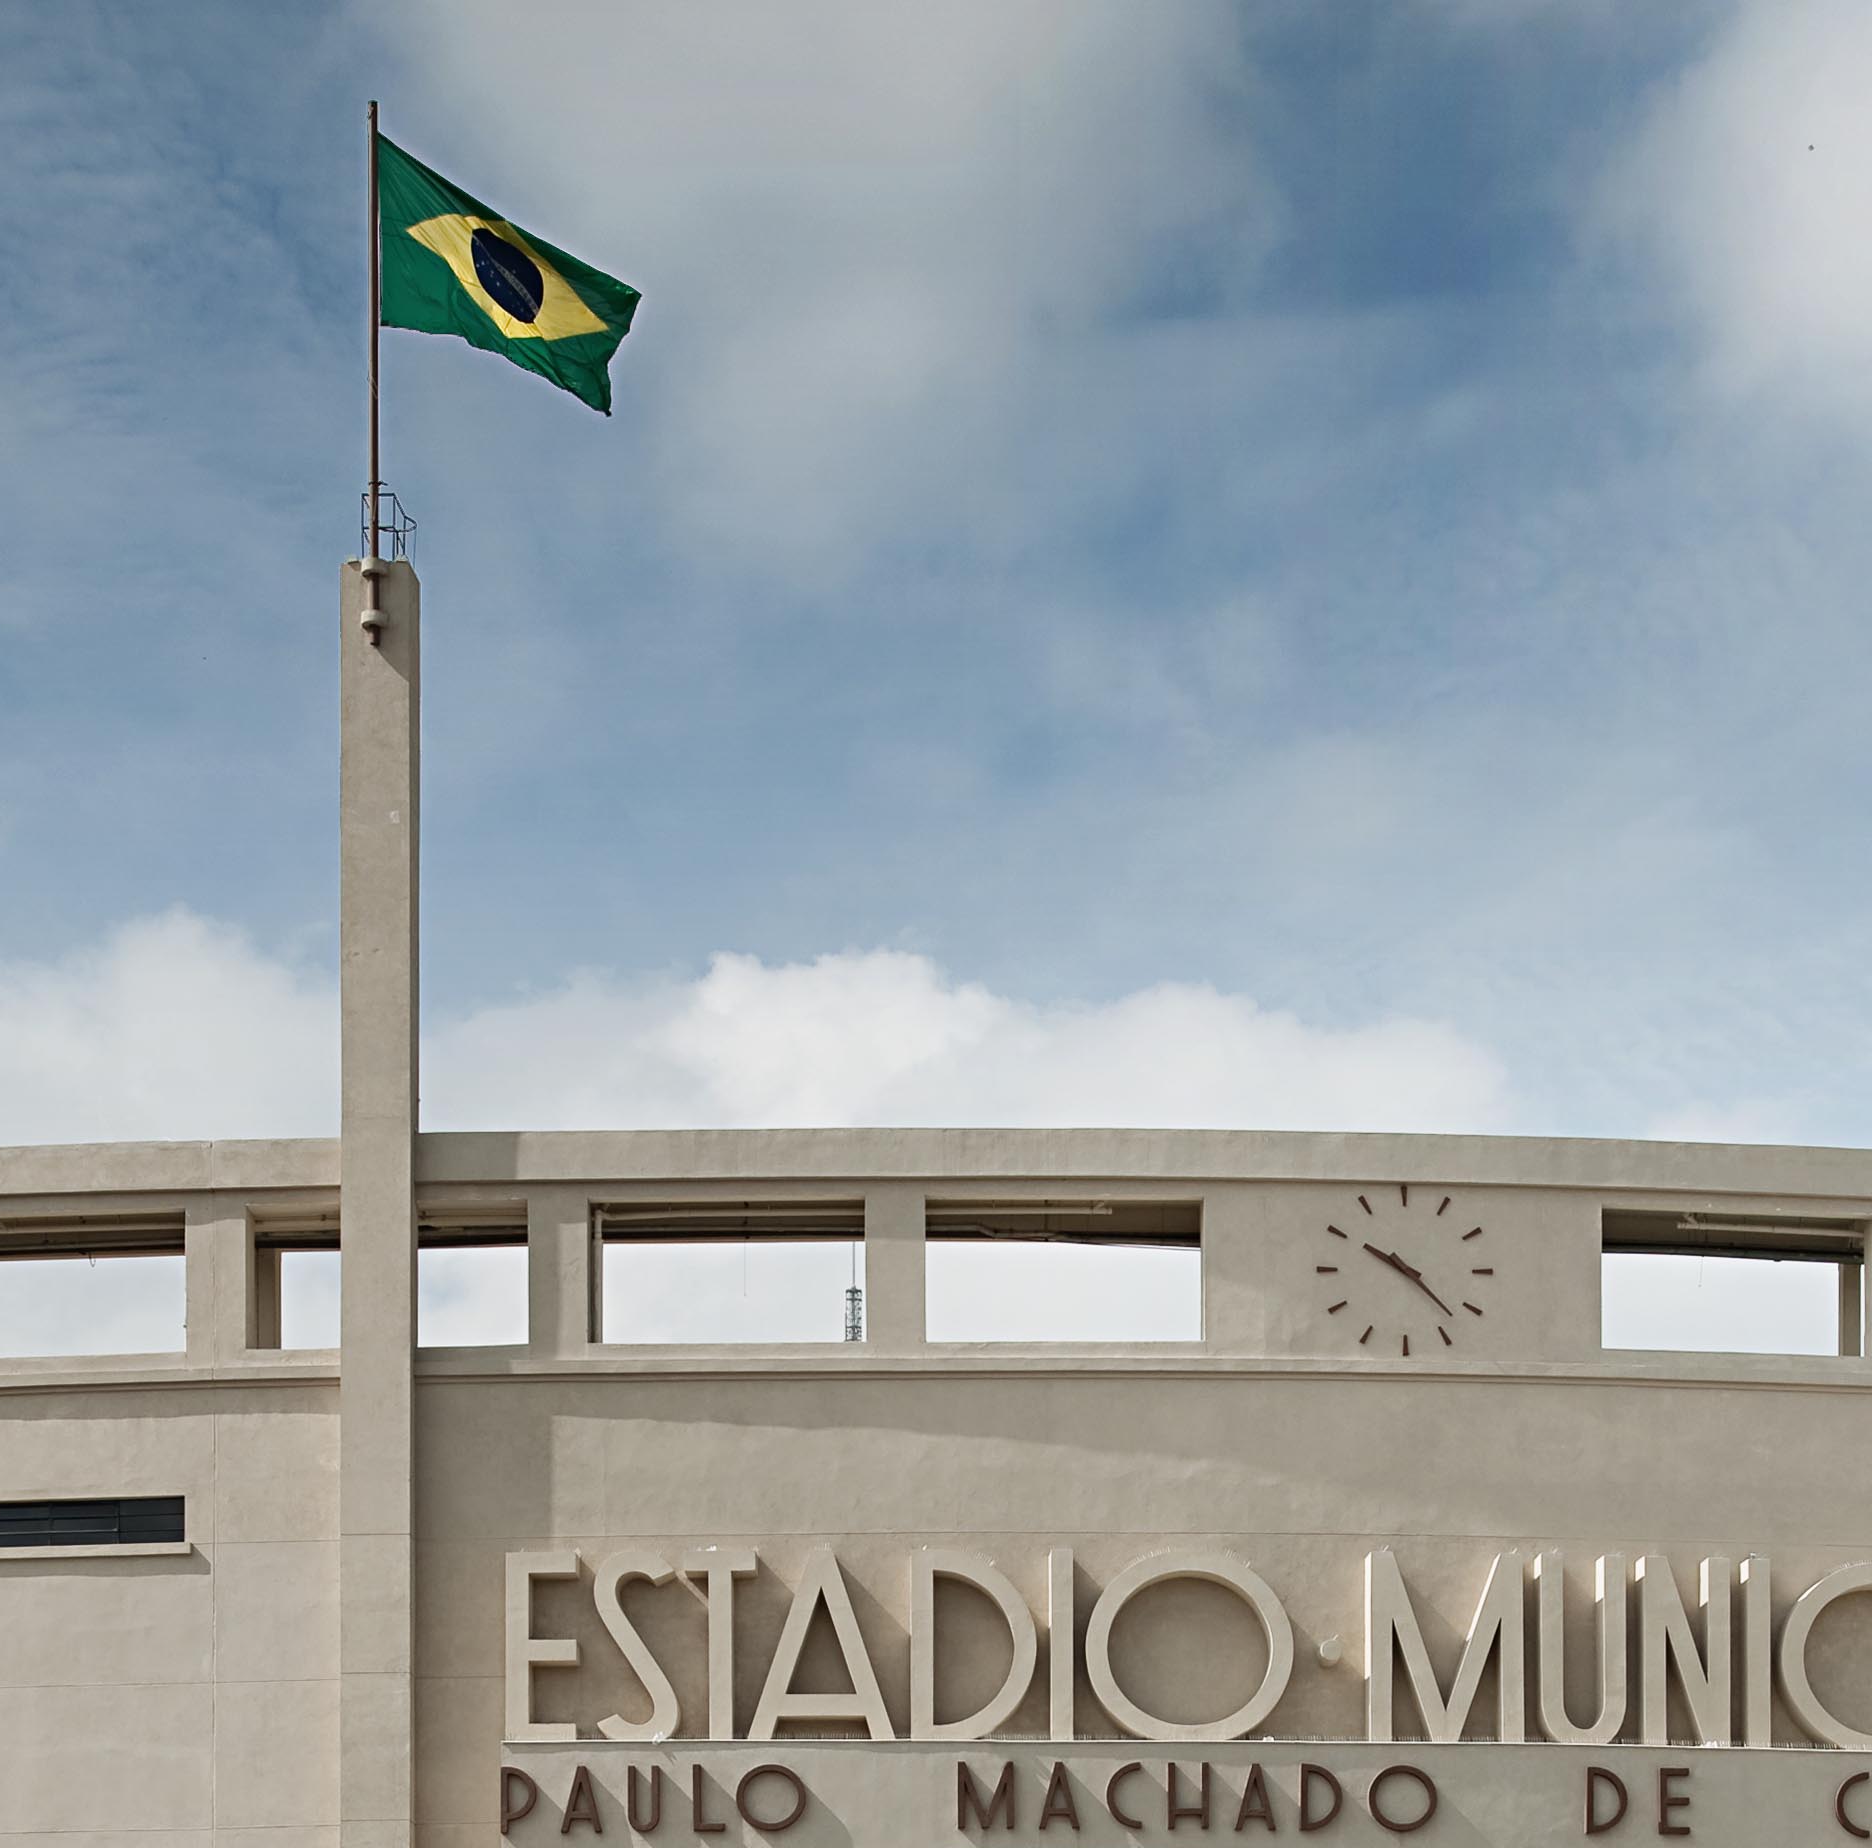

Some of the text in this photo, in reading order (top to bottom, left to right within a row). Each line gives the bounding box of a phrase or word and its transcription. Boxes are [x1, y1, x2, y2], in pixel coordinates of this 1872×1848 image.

[505, 1547, 1294, 1743] ESTADIO
[500, 1763, 807, 1835] PAULO
[957, 1761, 1438, 1832] MACHADO
[1585, 1765, 1691, 1836] DE
